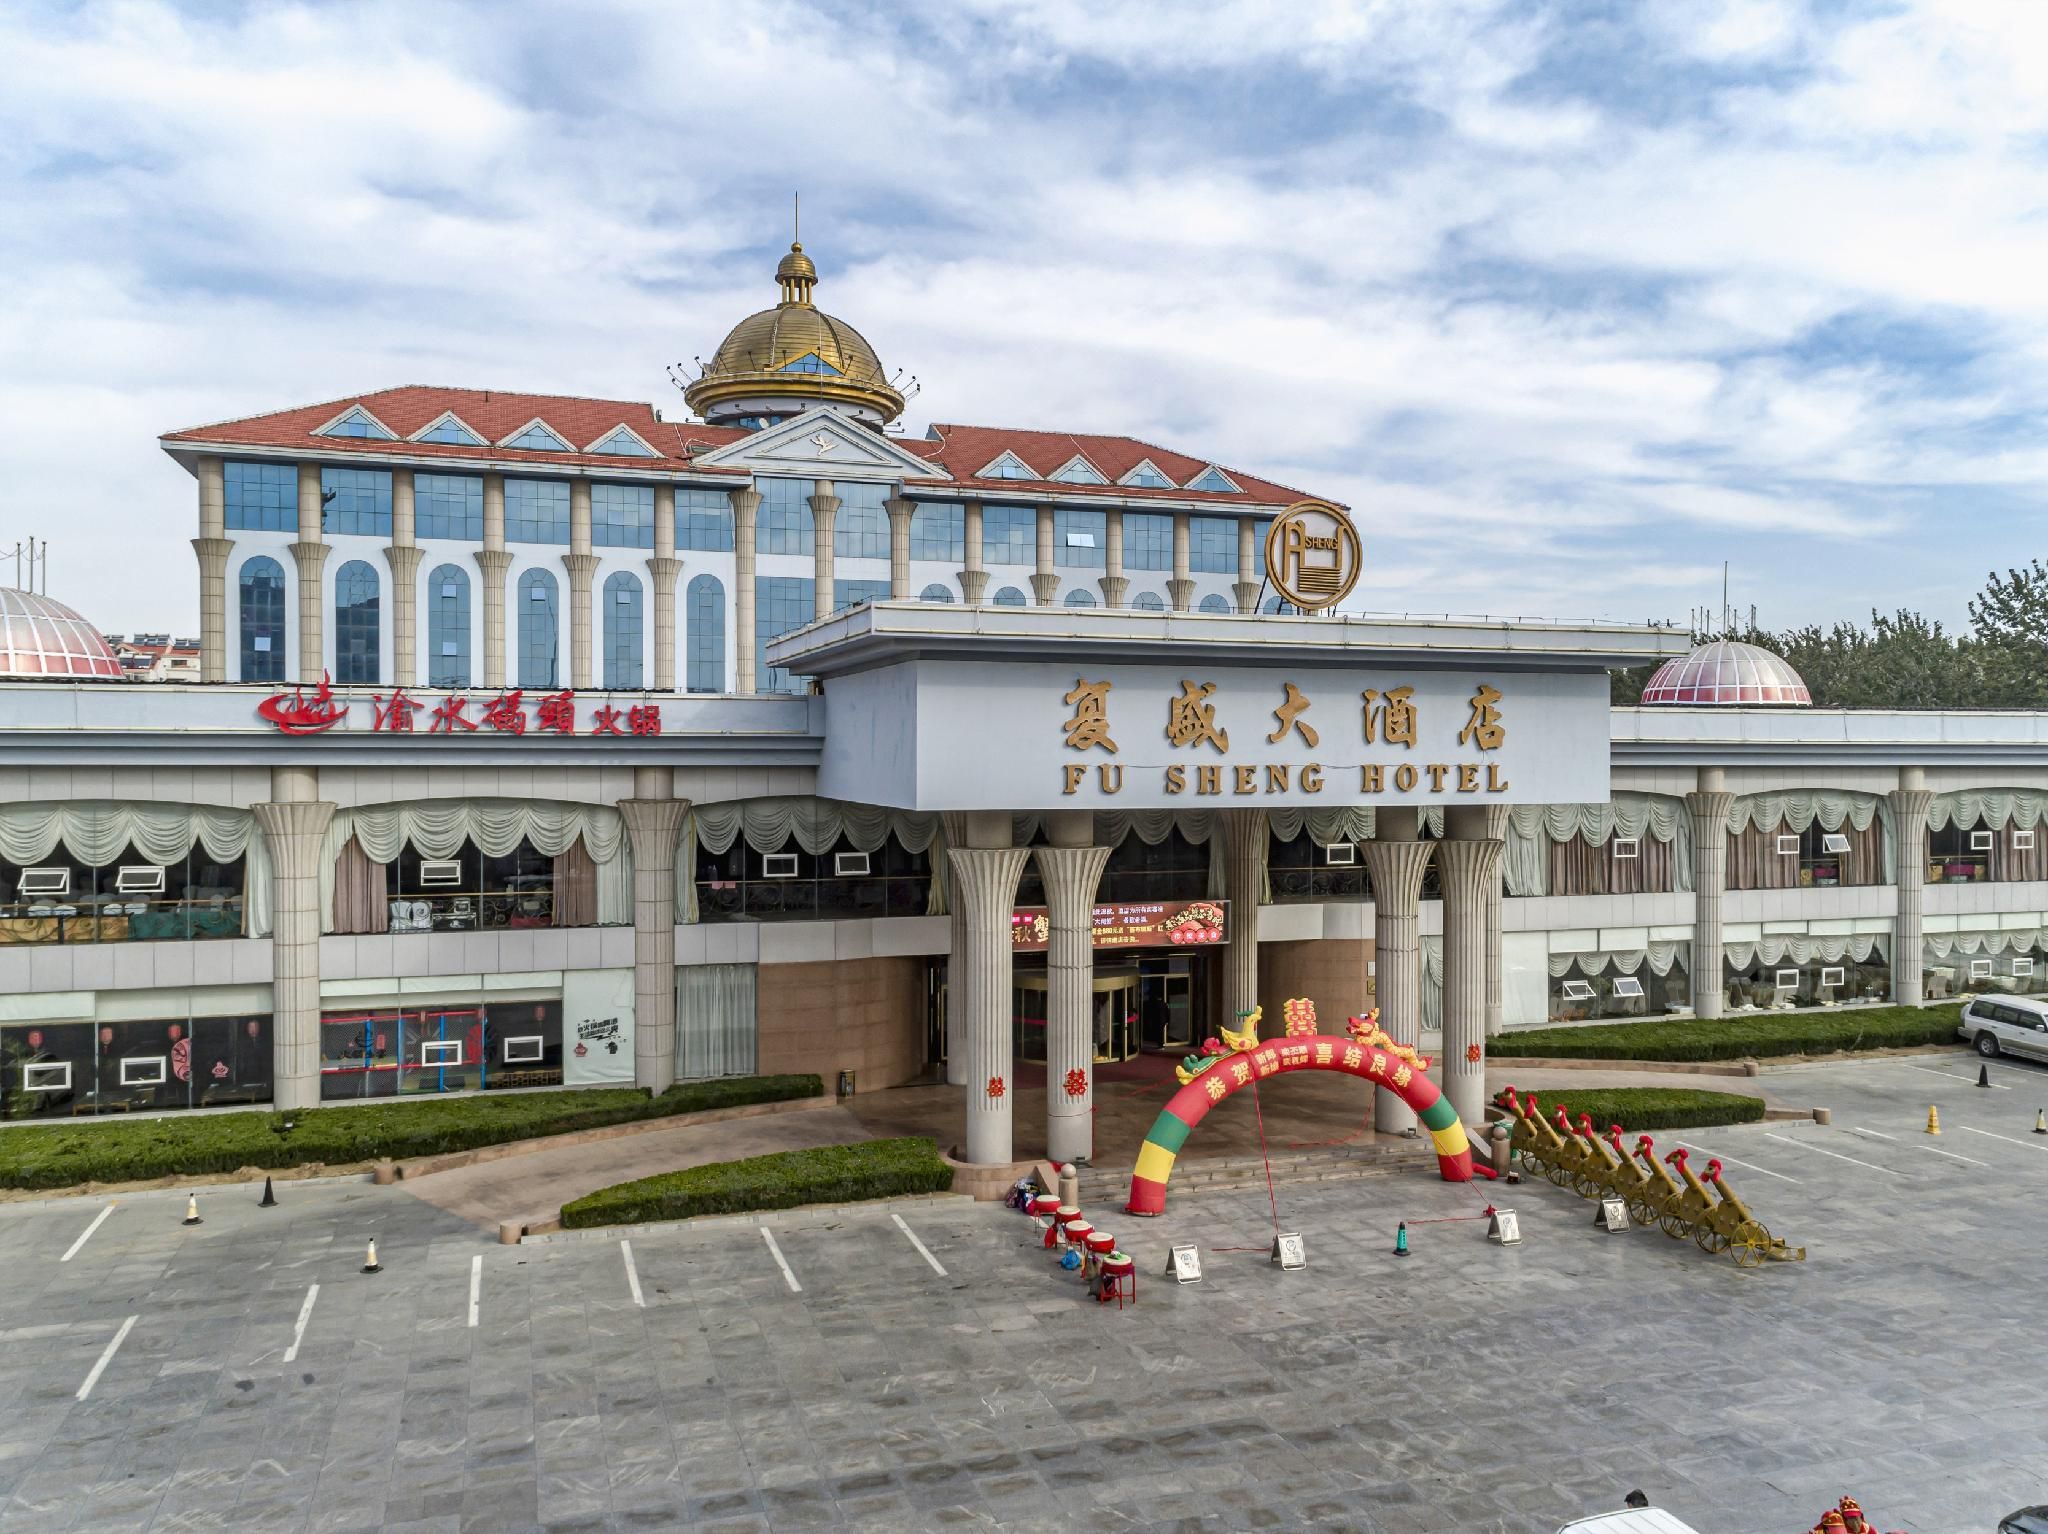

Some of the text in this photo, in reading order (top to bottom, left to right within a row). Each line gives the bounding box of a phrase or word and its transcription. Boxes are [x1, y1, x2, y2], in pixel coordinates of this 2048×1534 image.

[1305, 536, 1338, 550] SHENG
[1063, 762, 1510, 794] FU SHENG HOTEL
[1315, 1042, 1413, 1088] 喜结良缘
